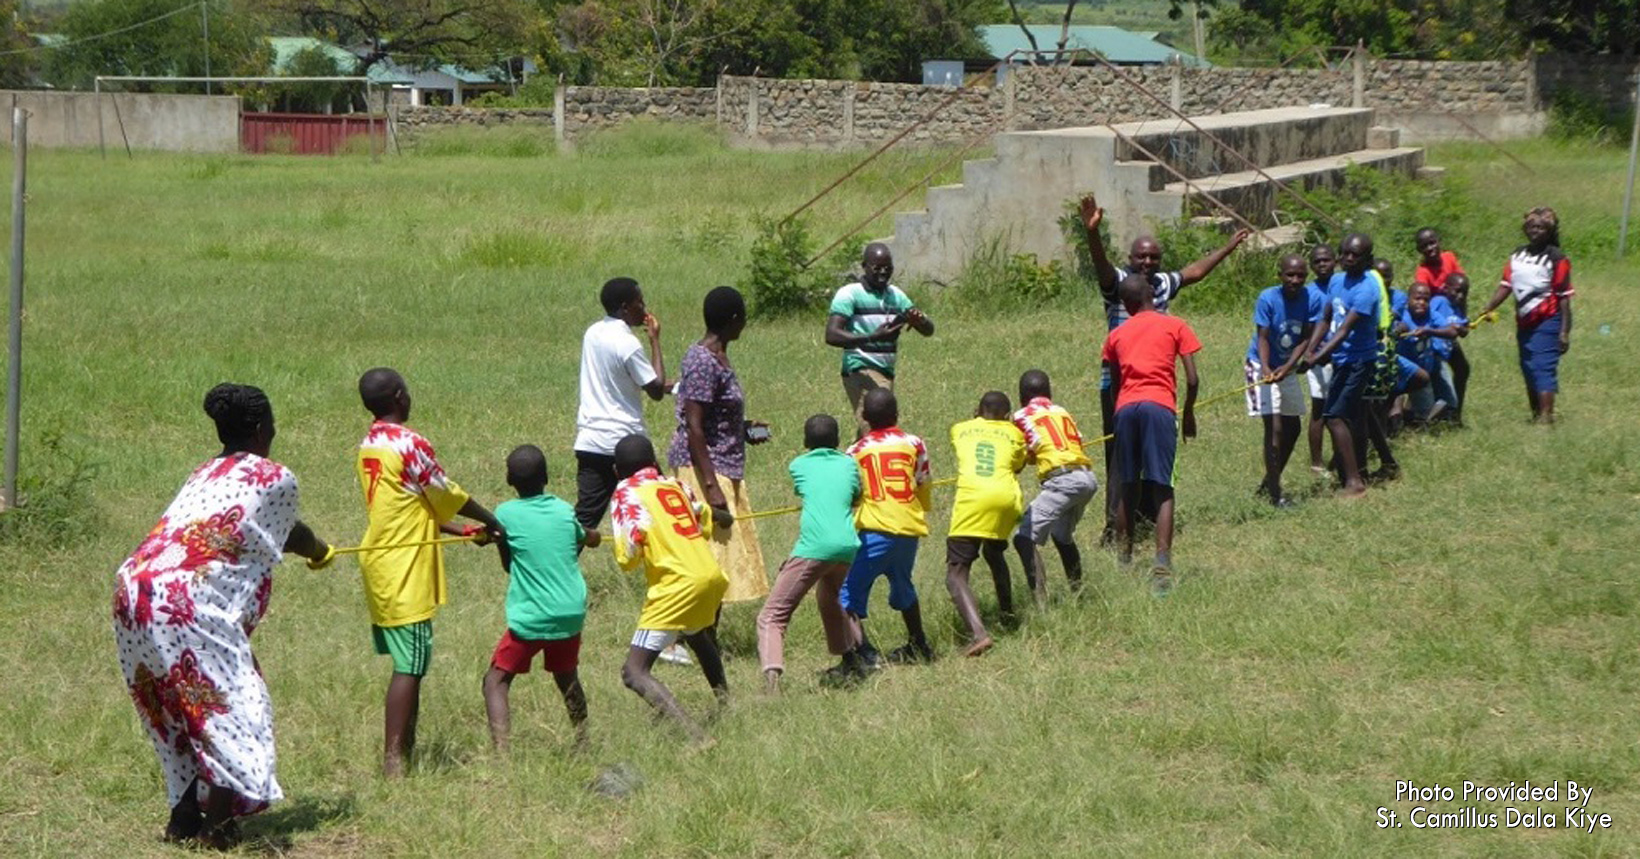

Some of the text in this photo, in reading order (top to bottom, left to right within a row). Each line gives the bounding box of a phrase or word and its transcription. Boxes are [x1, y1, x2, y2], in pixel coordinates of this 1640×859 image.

[1035, 415, 1082, 451] 14
[361, 457, 383, 507] 7
[859, 452, 917, 503] 15
[657, 487, 702, 540] 9
